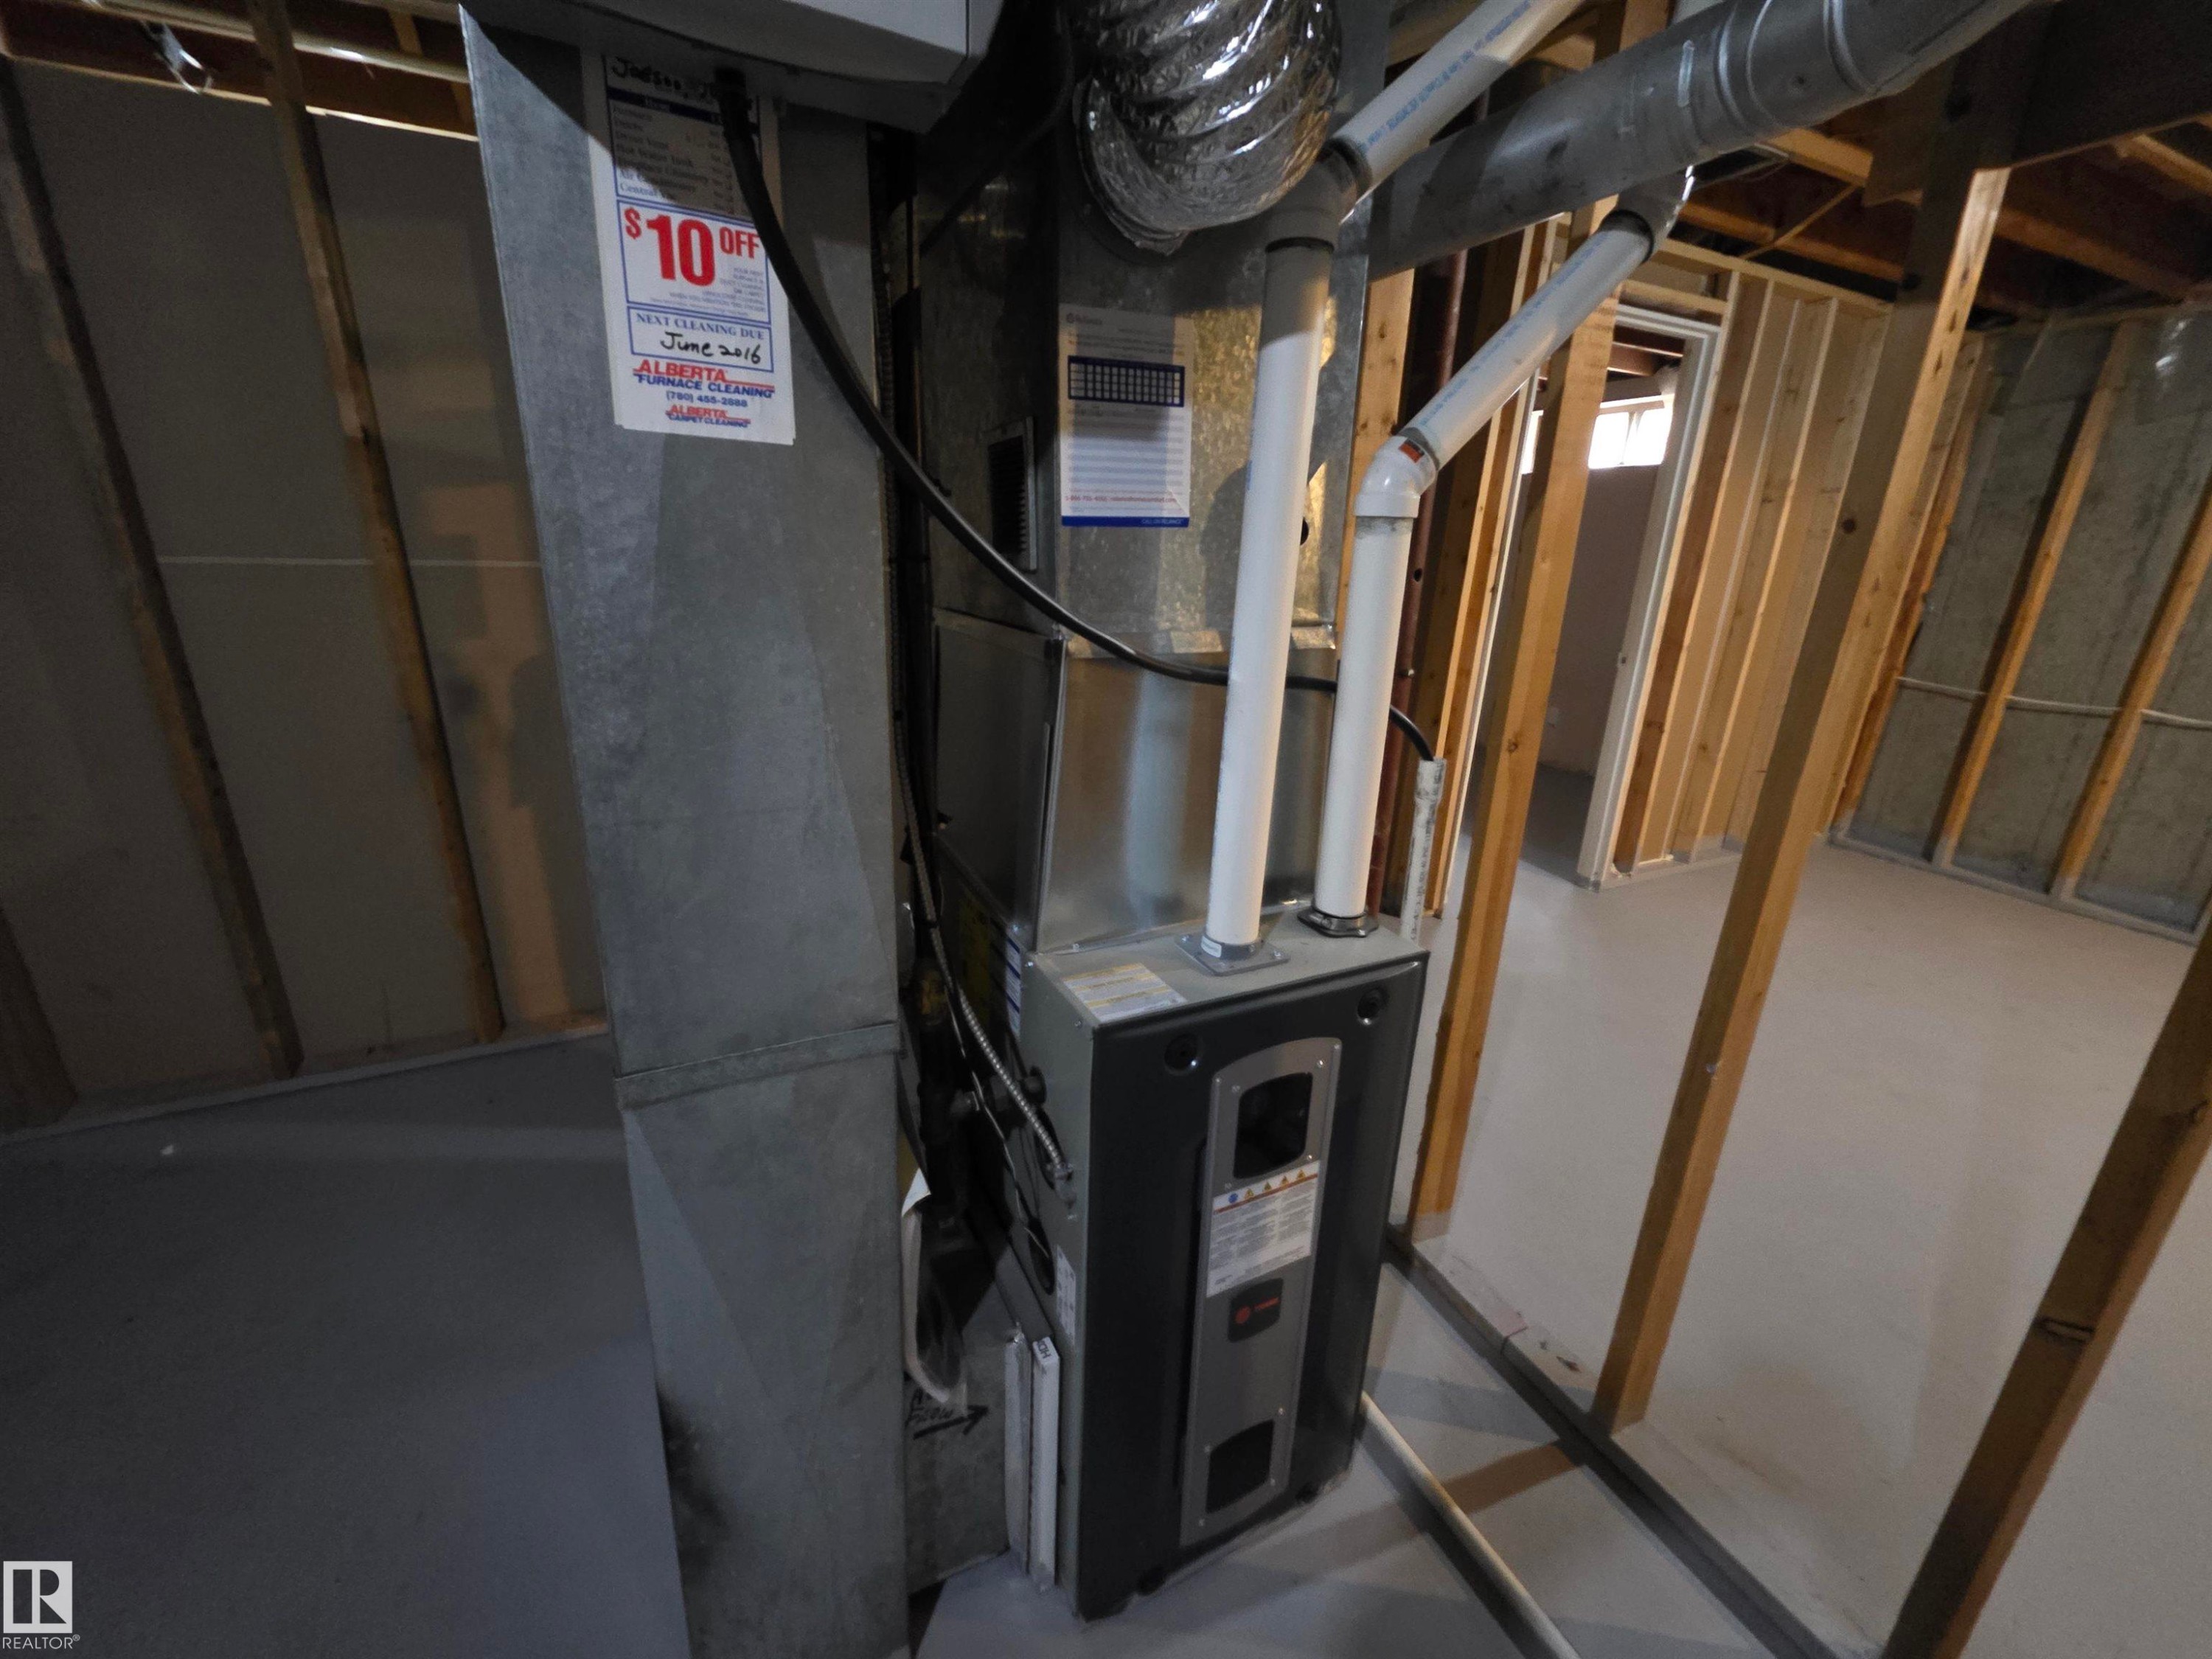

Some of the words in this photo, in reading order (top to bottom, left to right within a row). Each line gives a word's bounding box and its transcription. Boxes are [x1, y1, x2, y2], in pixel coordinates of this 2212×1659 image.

[720, 226, 759, 259] OFF
[637, 313, 669, 326] NEXT
[675, 318, 737, 336] CLEANING
[740, 328, 764, 340] DUE
[661, 332, 713, 356] June
[719, 344, 761, 364] 2016
[635, 359, 727, 383] ALBERTA
[637, 374, 702, 390] FURNACE
[708, 382, 773, 399] CLEANING
[667, 391, 694, 403] (780)
[669, 405, 727, 418] ALBERTA
[705, 417, 748, 428] CLEANING
